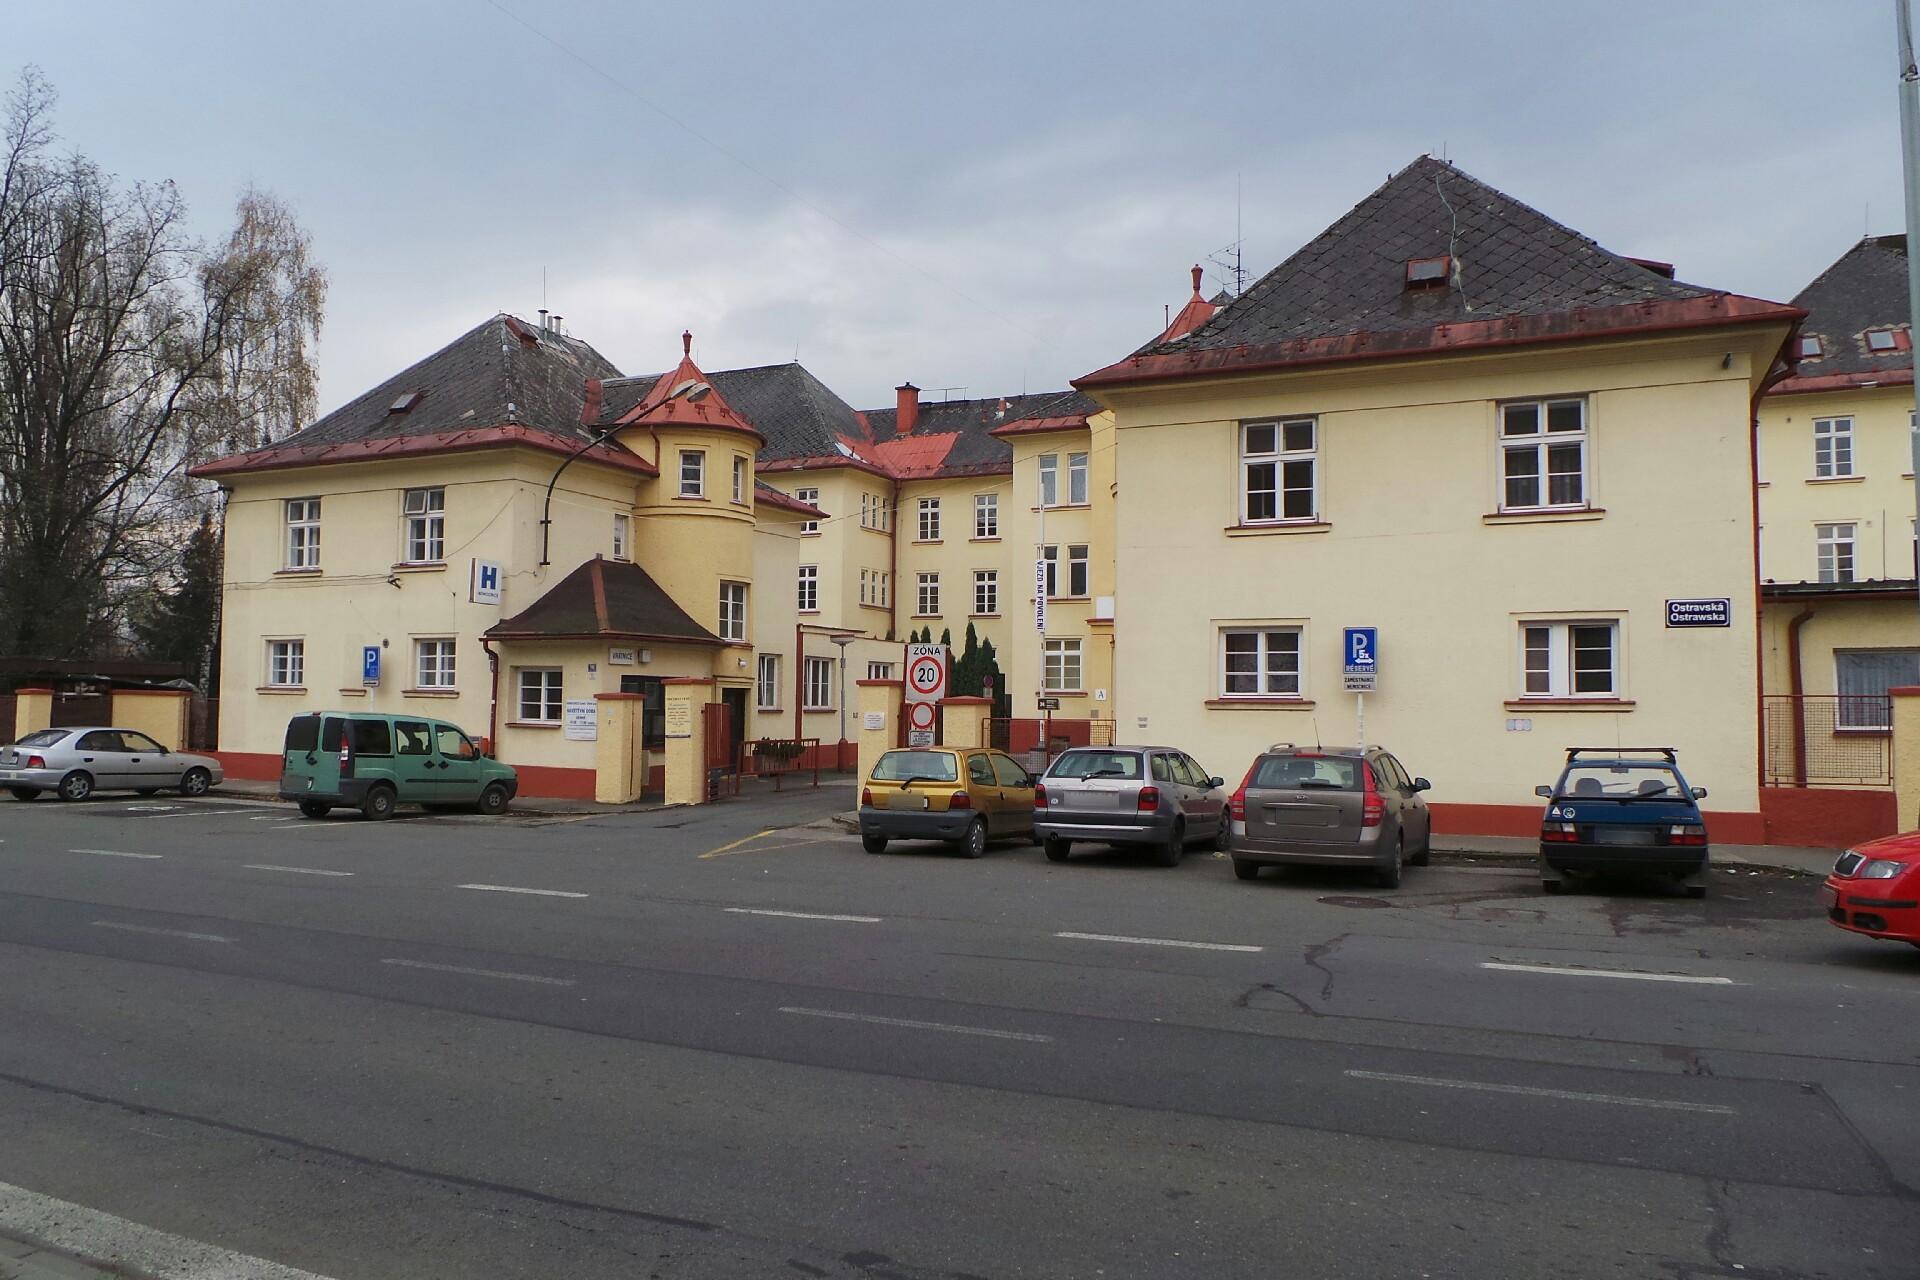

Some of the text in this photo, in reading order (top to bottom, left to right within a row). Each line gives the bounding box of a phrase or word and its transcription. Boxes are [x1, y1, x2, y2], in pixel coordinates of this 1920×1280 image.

[481, 565, 497, 590] H
[1036, 560, 1044, 582] VJEZD
[1036, 584, 1044, 594] NA
[1671, 603, 1724, 612] Ostravská
[1670, 613, 1726, 621] Ostrawska
[913, 645, 941, 655] ZÓNA
[1352, 633, 1367, 658] P
[367, 650, 376, 669] P
[918, 668, 935, 682] 20
